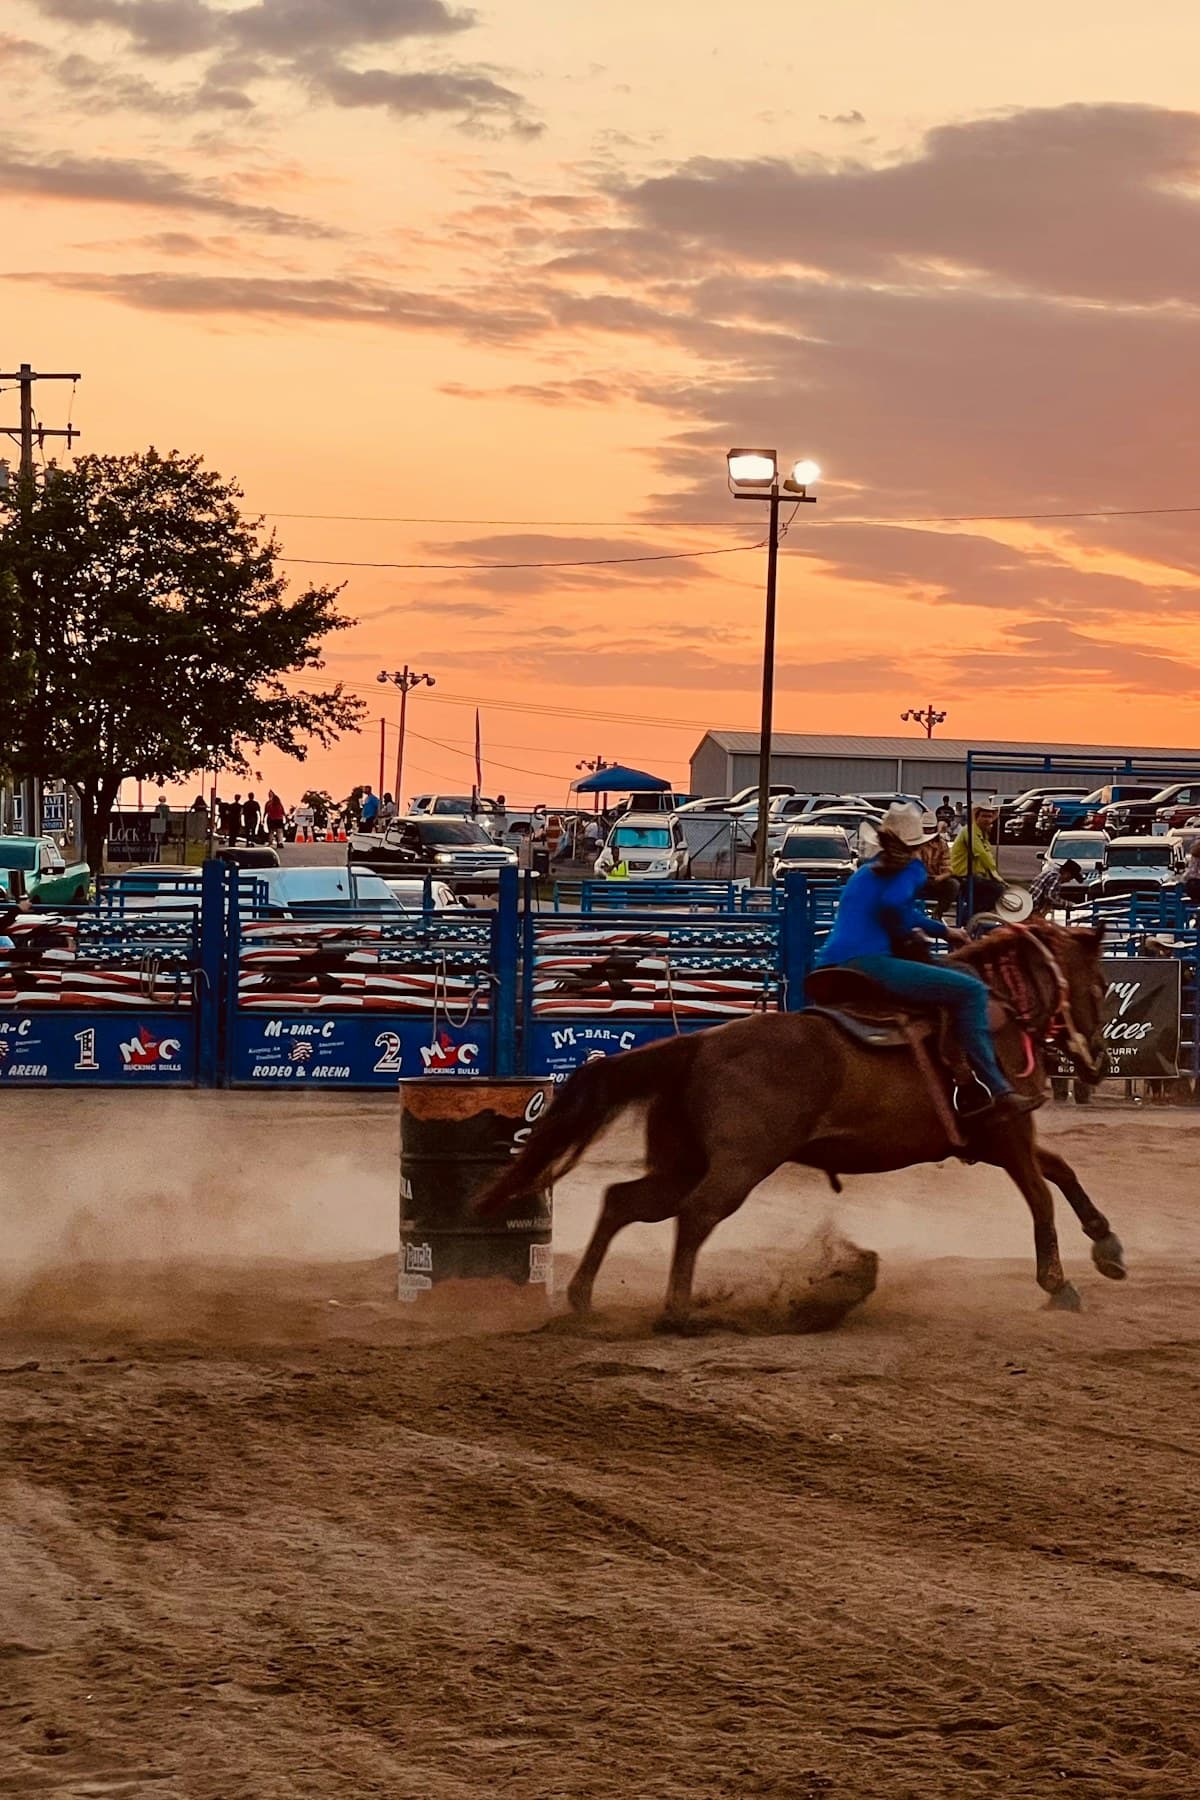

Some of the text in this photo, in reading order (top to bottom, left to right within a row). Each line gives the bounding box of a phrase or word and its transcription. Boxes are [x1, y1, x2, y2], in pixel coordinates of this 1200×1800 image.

[264, 1020, 336, 1038] M-BAR-C
[551, 1027, 636, 1050] M-BAR-C
[74, 1028, 100, 1070] 1
[373, 1031, 402, 1073] 2
[8, 1064, 48, 1077] ARENA
[252, 1065, 350, 1078] RODEO & ARENA
